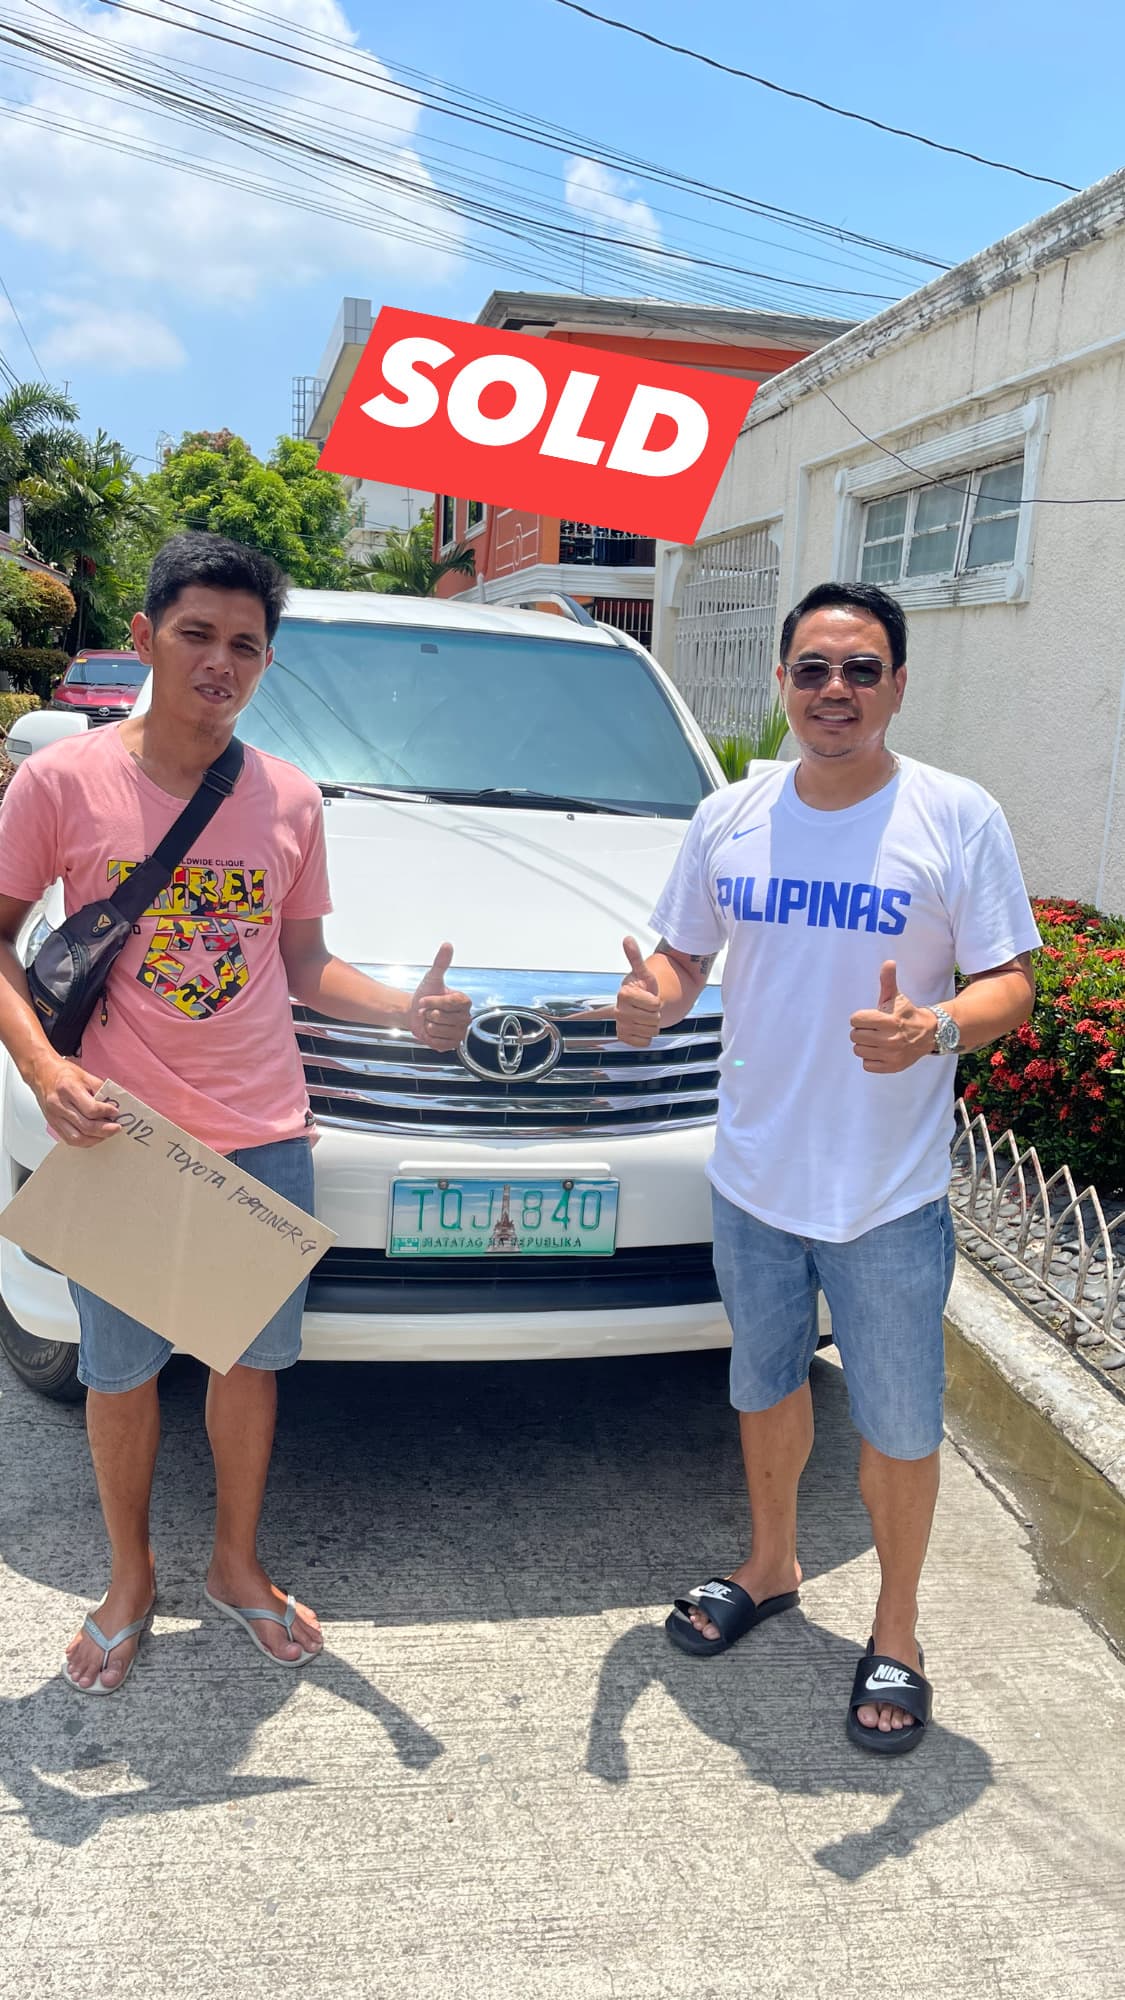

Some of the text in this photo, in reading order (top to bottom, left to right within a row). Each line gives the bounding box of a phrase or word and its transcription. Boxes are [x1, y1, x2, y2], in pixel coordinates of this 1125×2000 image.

[215, 859, 245, 868] CLIQUE
[717, 877, 911, 935] PILIPINAS
[167, 1140, 226, 1189] TOYOTA
[228, 1186, 303, 1244] FORTUNER
[301, 1239, 317, 1256] G
[411, 1189, 602, 1231] TQJ 840
[421, 1236, 483, 1248] MATATAG
[510, 1236, 582, 1248] REPUBLIKA
[705, 1581, 732, 1596] NIKE
[875, 1664, 911, 1682] NIKE
